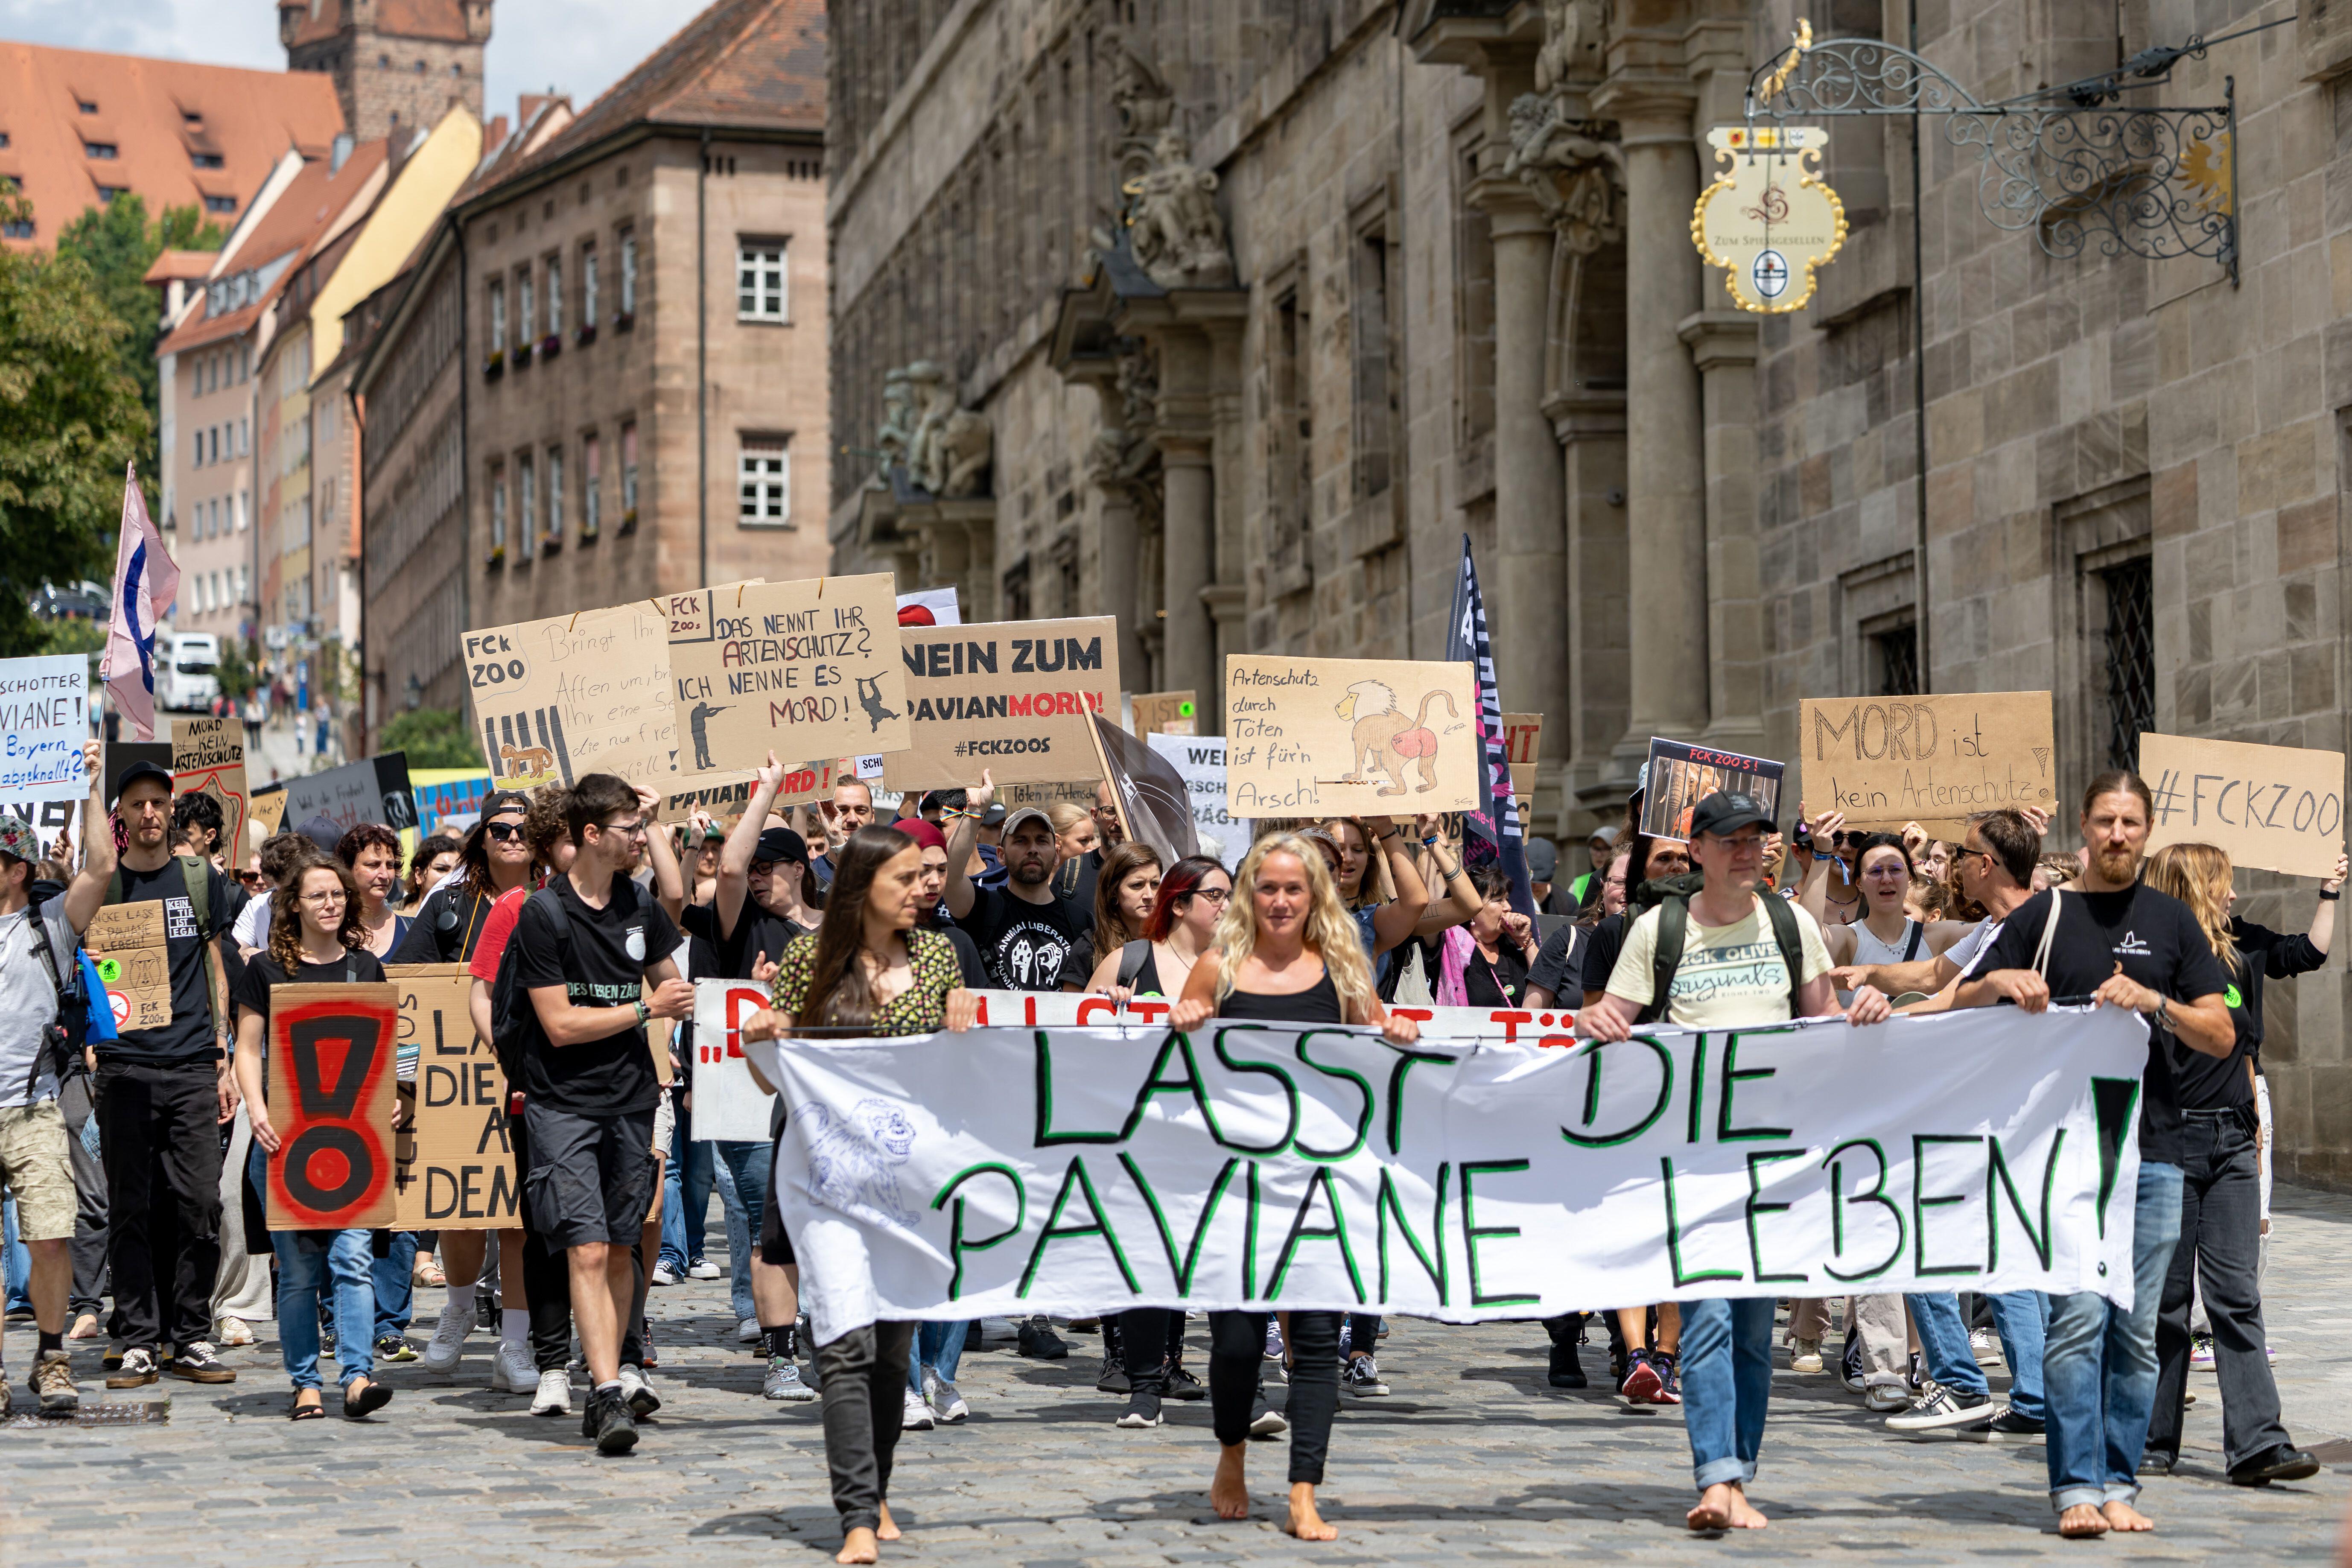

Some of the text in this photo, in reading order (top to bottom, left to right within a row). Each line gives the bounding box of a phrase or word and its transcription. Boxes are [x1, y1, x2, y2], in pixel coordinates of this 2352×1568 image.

[671, 597, 700, 616] FCK
[716, 606, 865, 639] DAS NENNT IHR
[542, 613, 654, 662] Bringt Ihr
[723, 628, 872, 667] ARTENSCHUTZ?
[902, 637, 1102, 677] NEIN ZUM
[472, 660, 525, 688] ZOO
[556, 672, 610, 704] Affen
[678, 664, 841, 701] ICH NENNE ES
[564, 704, 594, 727] Ihr
[607, 705, 641, 720] eine
[1232, 696, 1276, 713] durch
[188, 719, 222, 736] MORD
[1233, 718, 1283, 739] Töten
[1814, 704, 1989, 761] MORD ist
[7, 734, 69, 760] Bayern
[176, 732, 229, 753] ist KEIN
[573, 737, 599, 757] die
[609, 735, 631, 748] nur
[954, 737, 1050, 757] #FCKZOOS
[1234, 746, 1256, 765] ist
[1689, 748, 1714, 763] FCK
[174, 745, 242, 774] ARTENSCHUTZ
[1235, 776, 1320, 809] Arsch!
[1832, 777, 1888, 809] kein
[2150, 769, 2340, 837] #FCKZOO
[168, 899, 189, 909] KEIN
[175, 918, 188, 926] IST
[1725, 942, 1779, 961] OLIVE
[425, 1062, 496, 1107] DIE
[1033, 1024, 1794, 1161] LASST DIE
[931, 1077, 2139, 1308] PAVIANE LEBEN!
